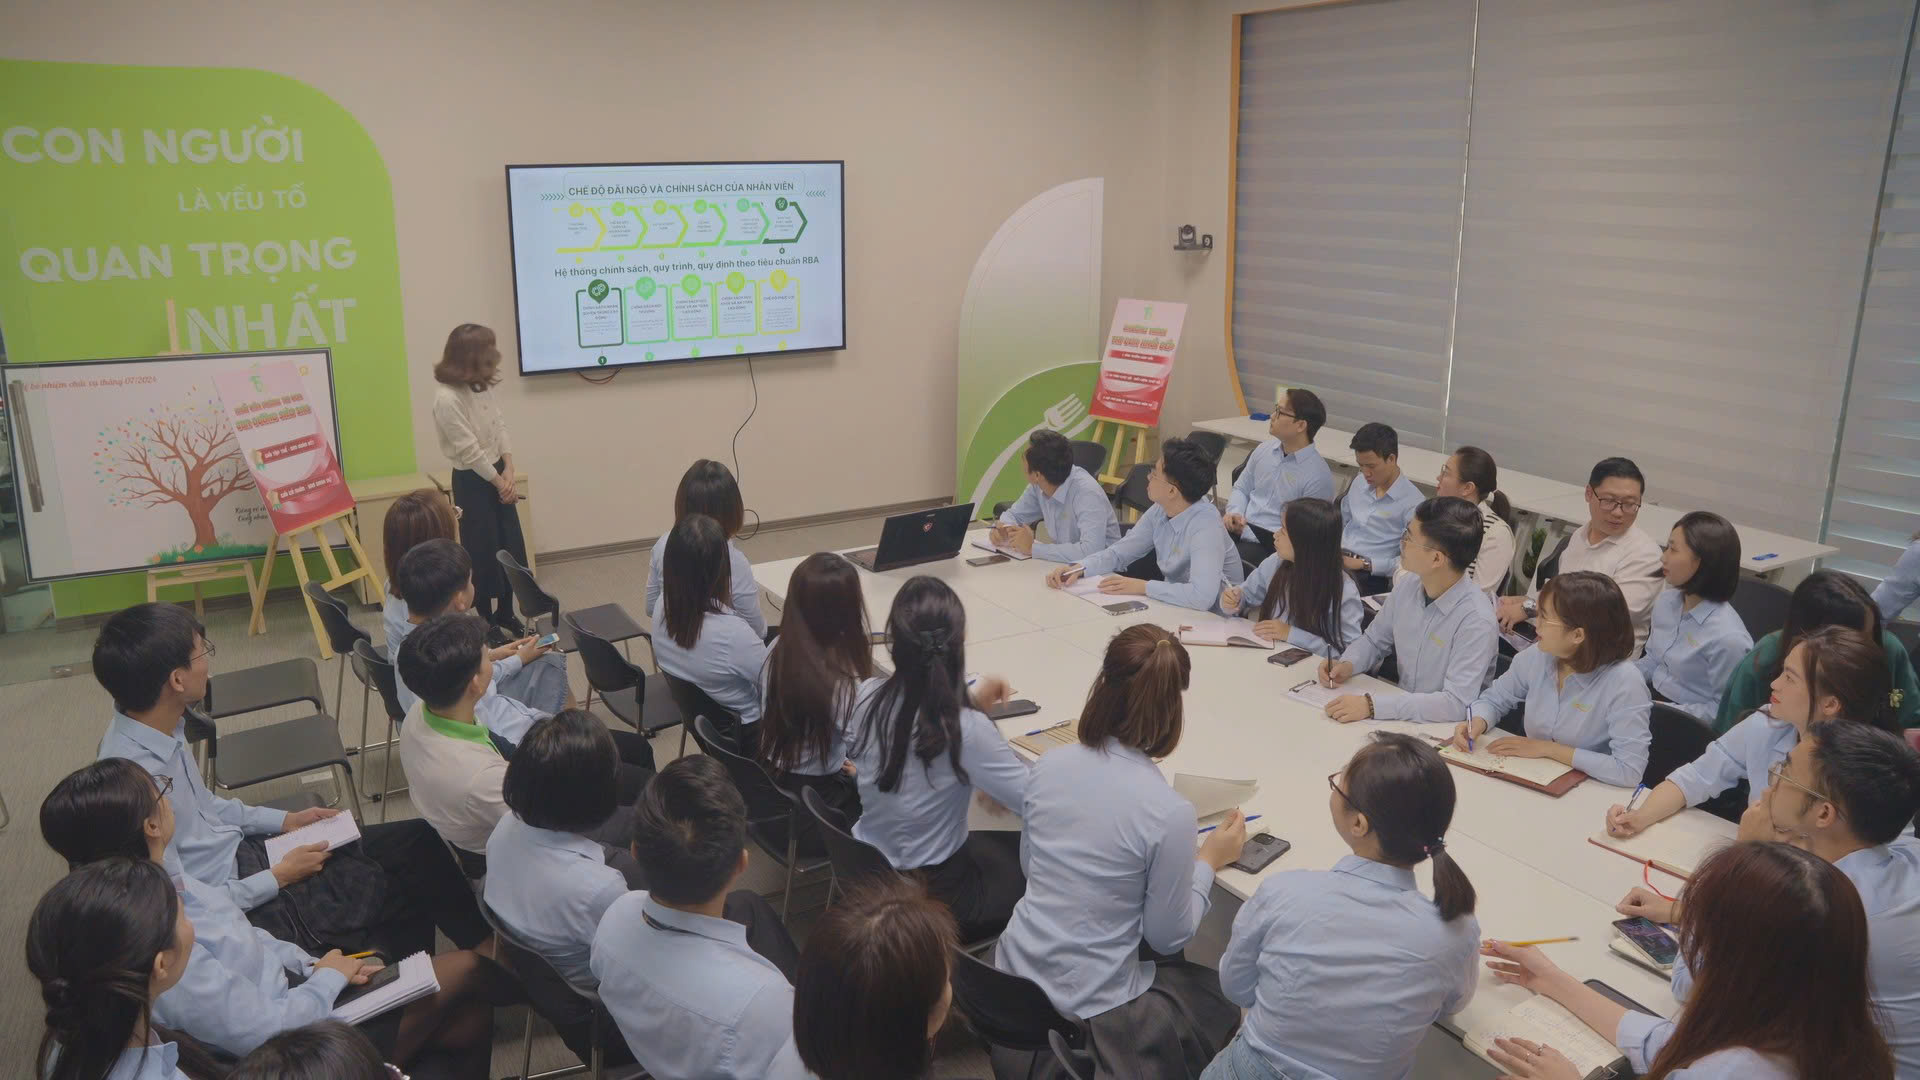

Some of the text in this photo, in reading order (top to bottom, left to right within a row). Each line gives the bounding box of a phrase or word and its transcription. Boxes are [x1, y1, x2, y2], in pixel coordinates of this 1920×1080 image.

[2, 114, 304, 164] CON NGƯỜI
[178, 180, 307, 212] LÀ YẾU TỐ
[649, 182, 663, 194] VÀ
[19, 236, 357, 283] QUAN TRỌNG
[554, 267, 567, 279] Hệ
[653, 264, 670, 273] quy
[697, 263, 714, 271] quy
[737, 259, 755, 268] theo
[802, 255, 820, 264] RBA
[186, 283, 357, 352] NHẤT
